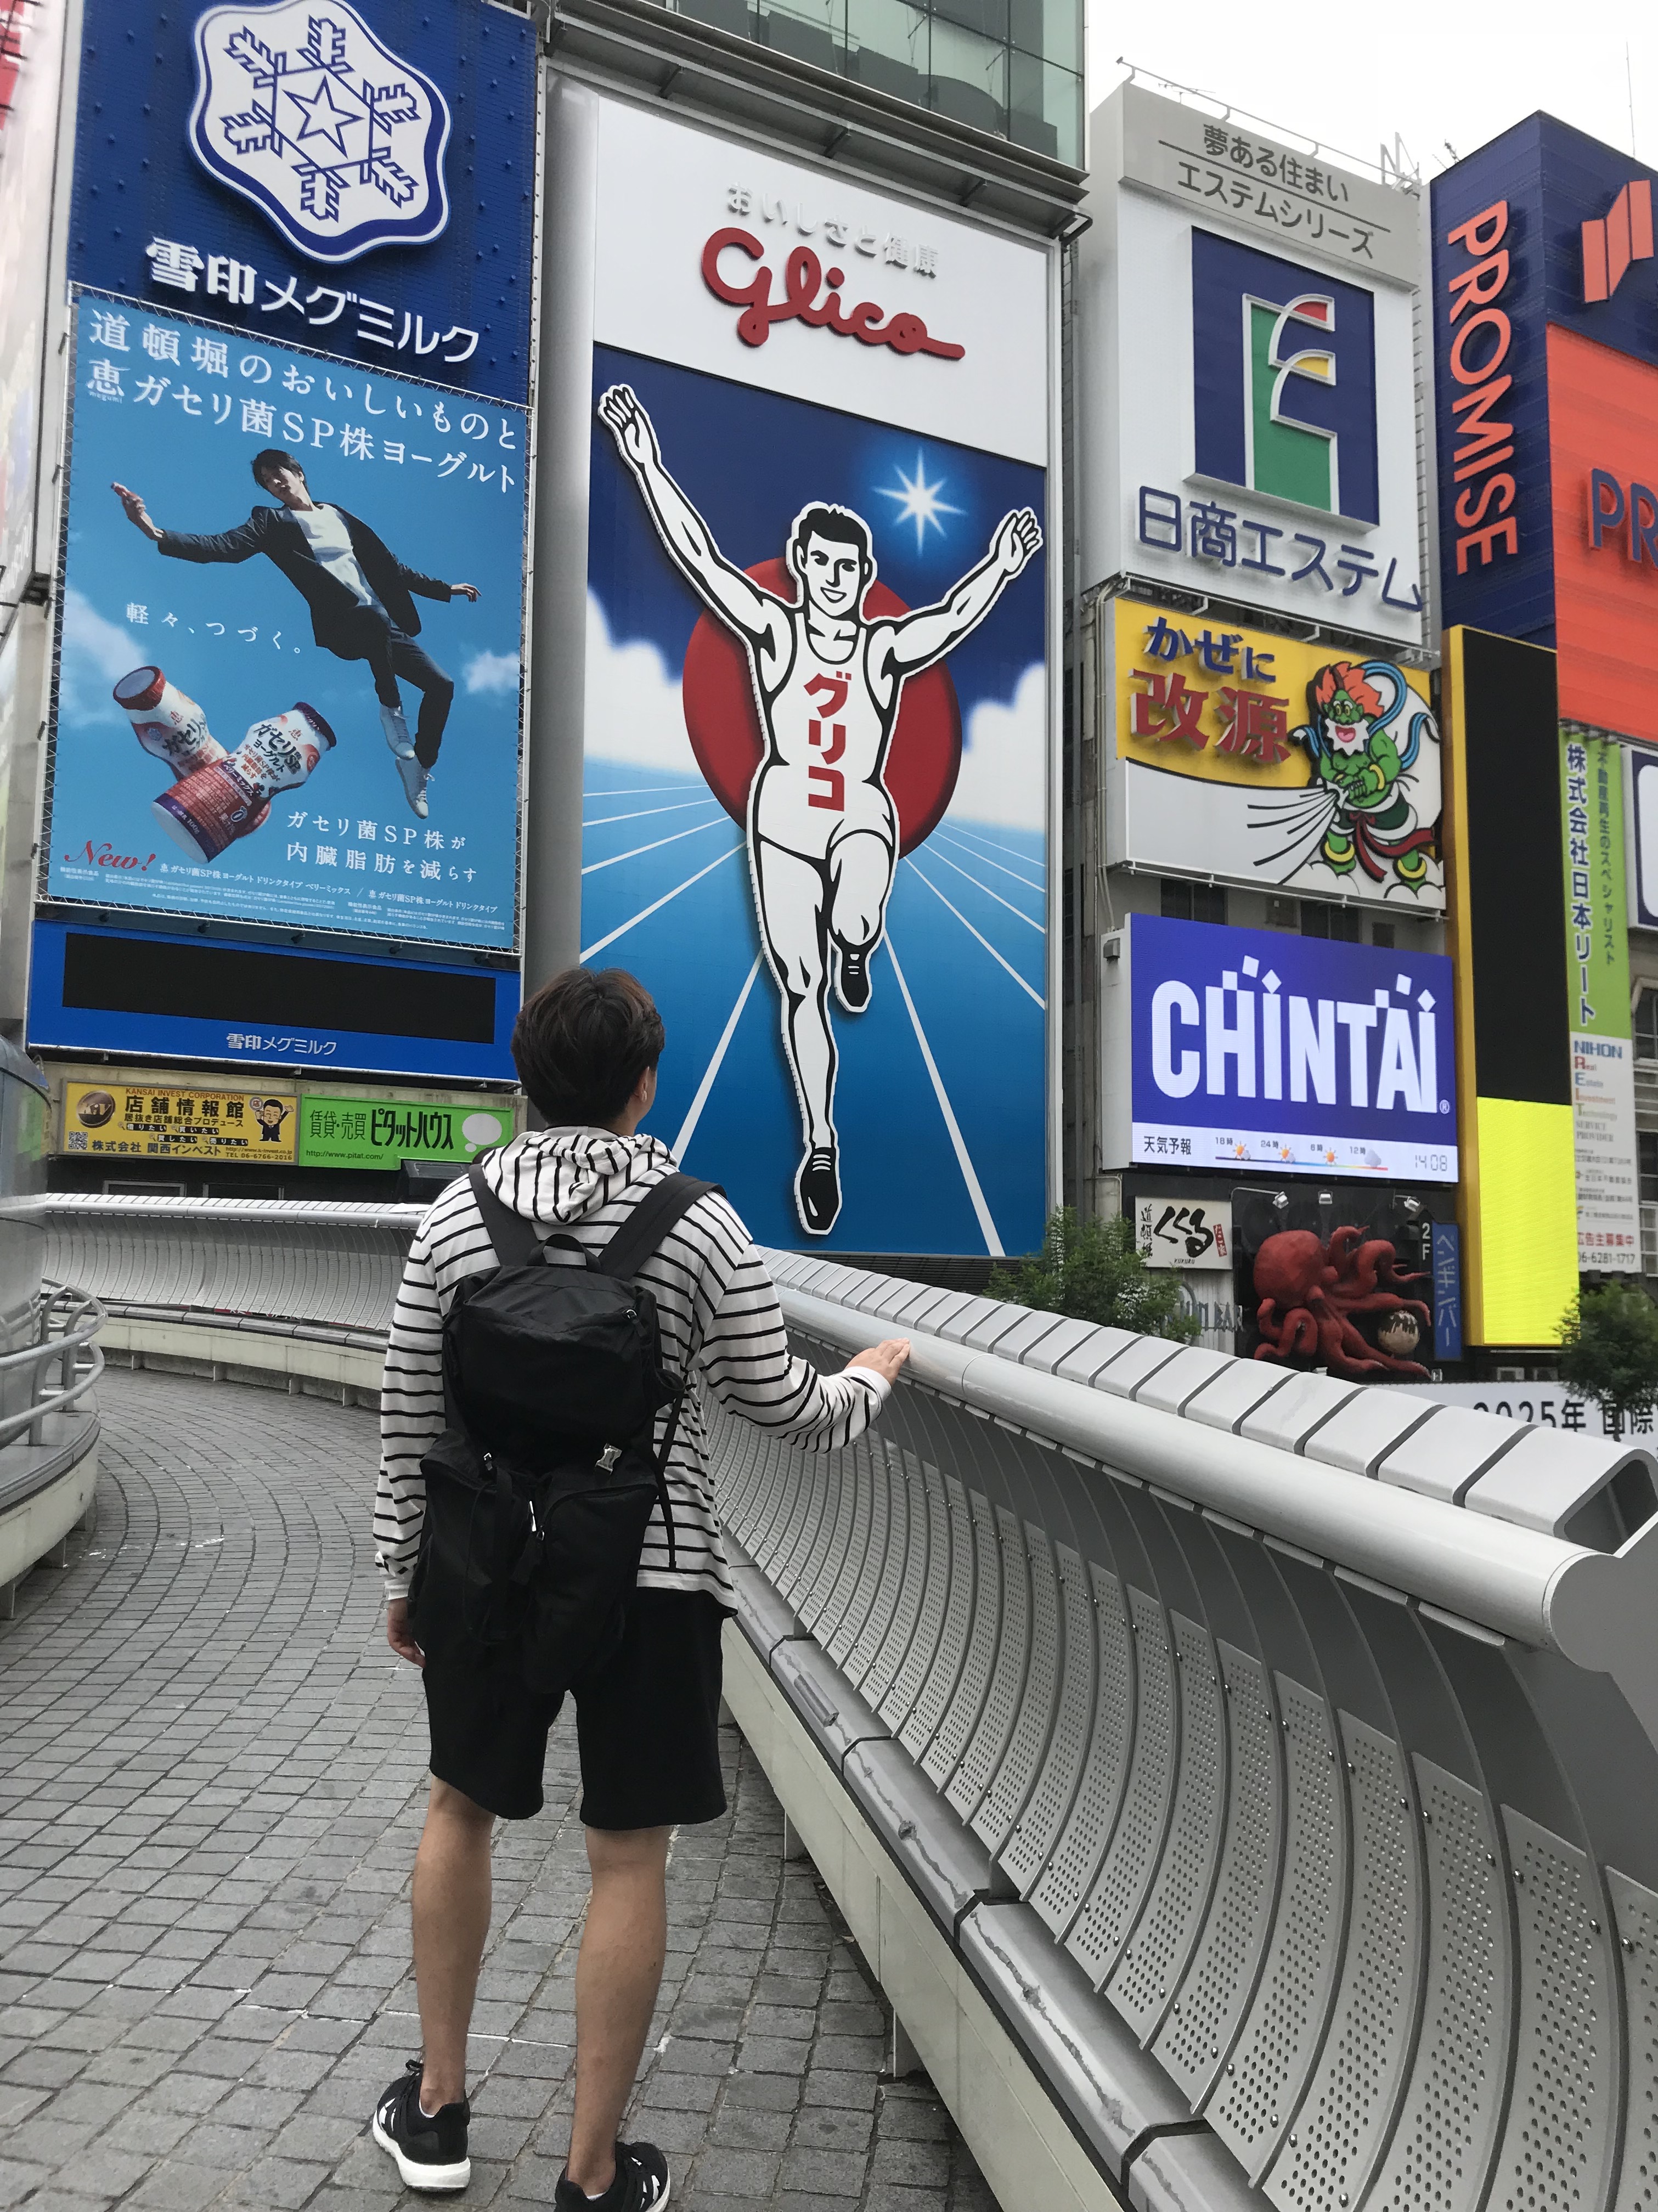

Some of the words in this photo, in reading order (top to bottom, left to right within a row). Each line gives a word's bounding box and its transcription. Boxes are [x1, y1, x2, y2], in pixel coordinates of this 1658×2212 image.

[1203, 123, 1348, 202] 夢ある住まい
[727, 182, 939, 278] おいしさと健康
[1177, 161, 1374, 259] エステムシリーズ
[146, 236, 479, 364] 雪印メグミルク
[701, 227, 966, 360] Glico
[89, 309, 518, 450] 道頓堀のおいしいものと
[1447, 200, 1518, 575] PROMISE
[1138, 486, 1423, 612] 日商エステム
[125, 602, 302, 654] 軽々、つづく。
[1143, 616, 1277, 683] かぜに
[803, 670, 851, 812] グリコ
[1129, 668, 1291, 765] 改源
[64, 840, 156, 871] New!
[287, 811, 466, 850] ガセリ菌SP株が
[287, 842, 477, 882] 内臓脂肪を減らす
[1567, 743, 1595, 1026] 株式会社日本リート
[226, 1033, 337, 1055] 雪印メグミルク
[1152, 956, 1437, 1113] CHINTAI
[1574, 1040, 1622, 1059] NIHON
[124, 1113, 244, 1127] 居抜き店舗総合プロデュース
[125, 1095, 244, 1119] 店舗情報館
[189, 1092, 244, 1102] CORPORATION
[92, 1140, 142, 1153] 株式会社
[306, 1149, 384, 1160] http://www.pitat.com/
[371, 1108, 454, 1150] ピタットハウス
[1144, 1136, 1192, 1155] 天気予報
[1153, 1206, 1214, 1258] くくる
